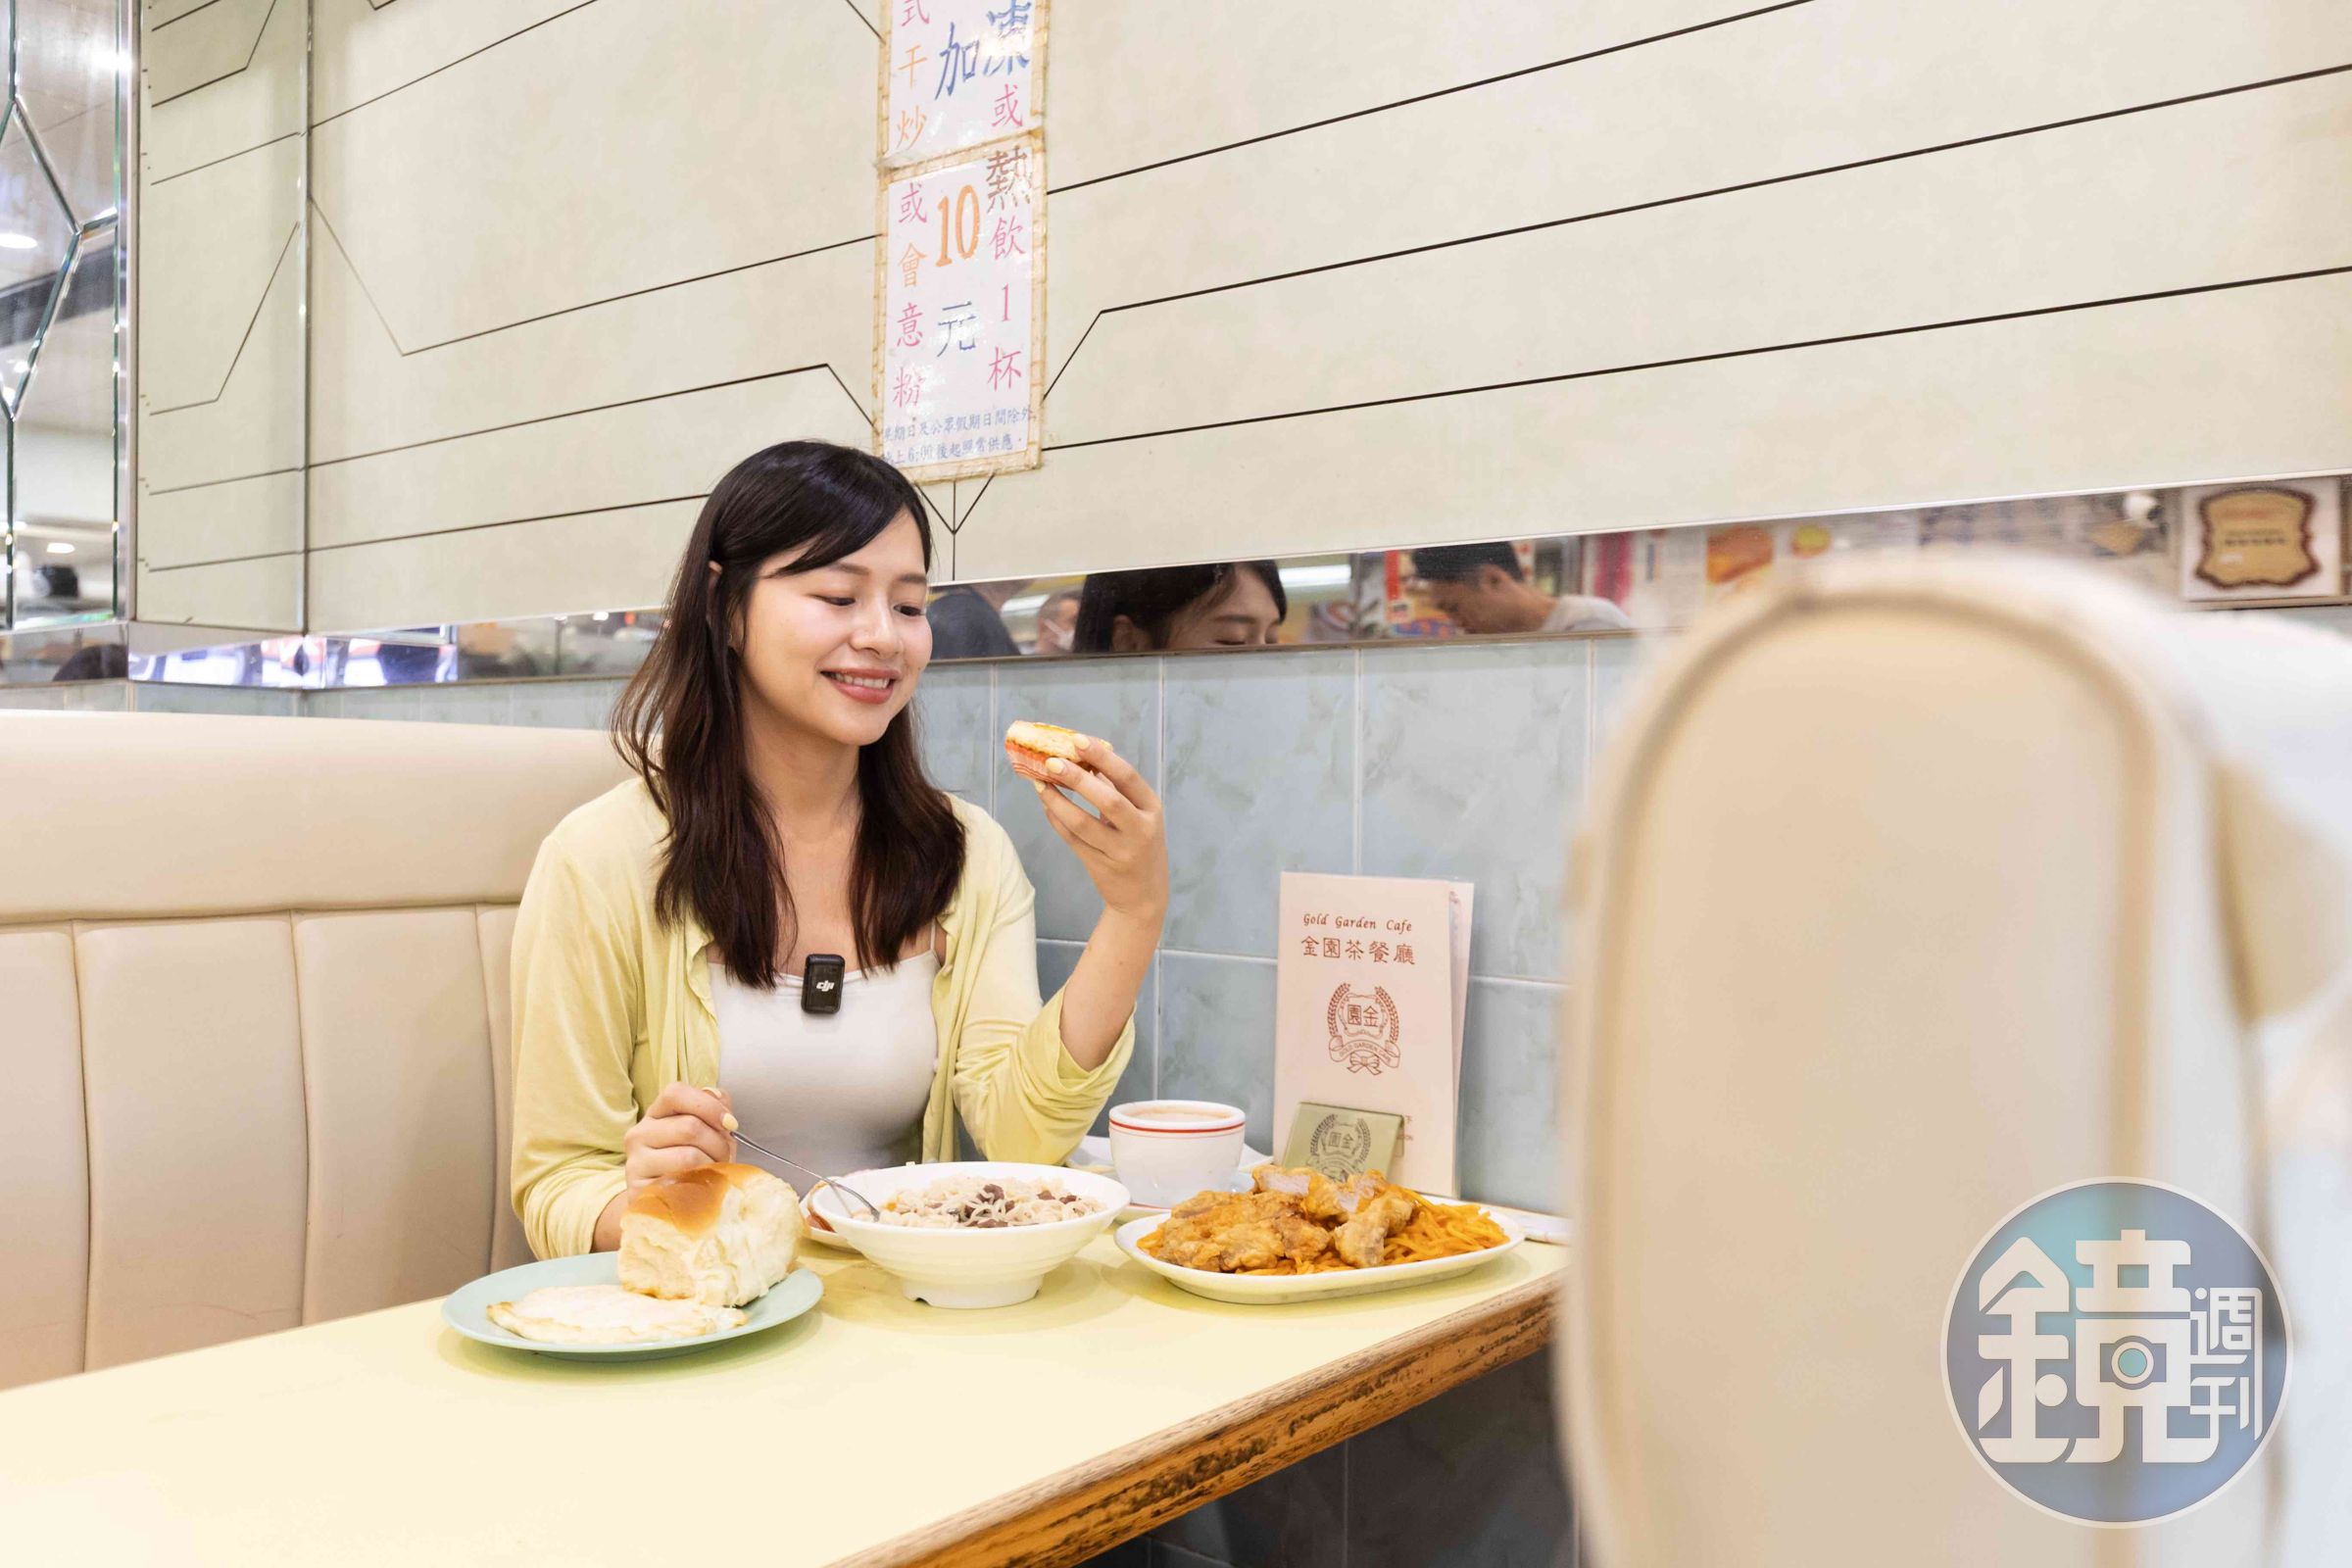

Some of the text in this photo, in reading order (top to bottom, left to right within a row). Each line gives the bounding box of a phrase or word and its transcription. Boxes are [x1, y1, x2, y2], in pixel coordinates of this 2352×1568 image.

[1303, 913, 1412, 935] Gold Garden Cafe
[1300, 935, 1415, 965] 金園茶餐廳
